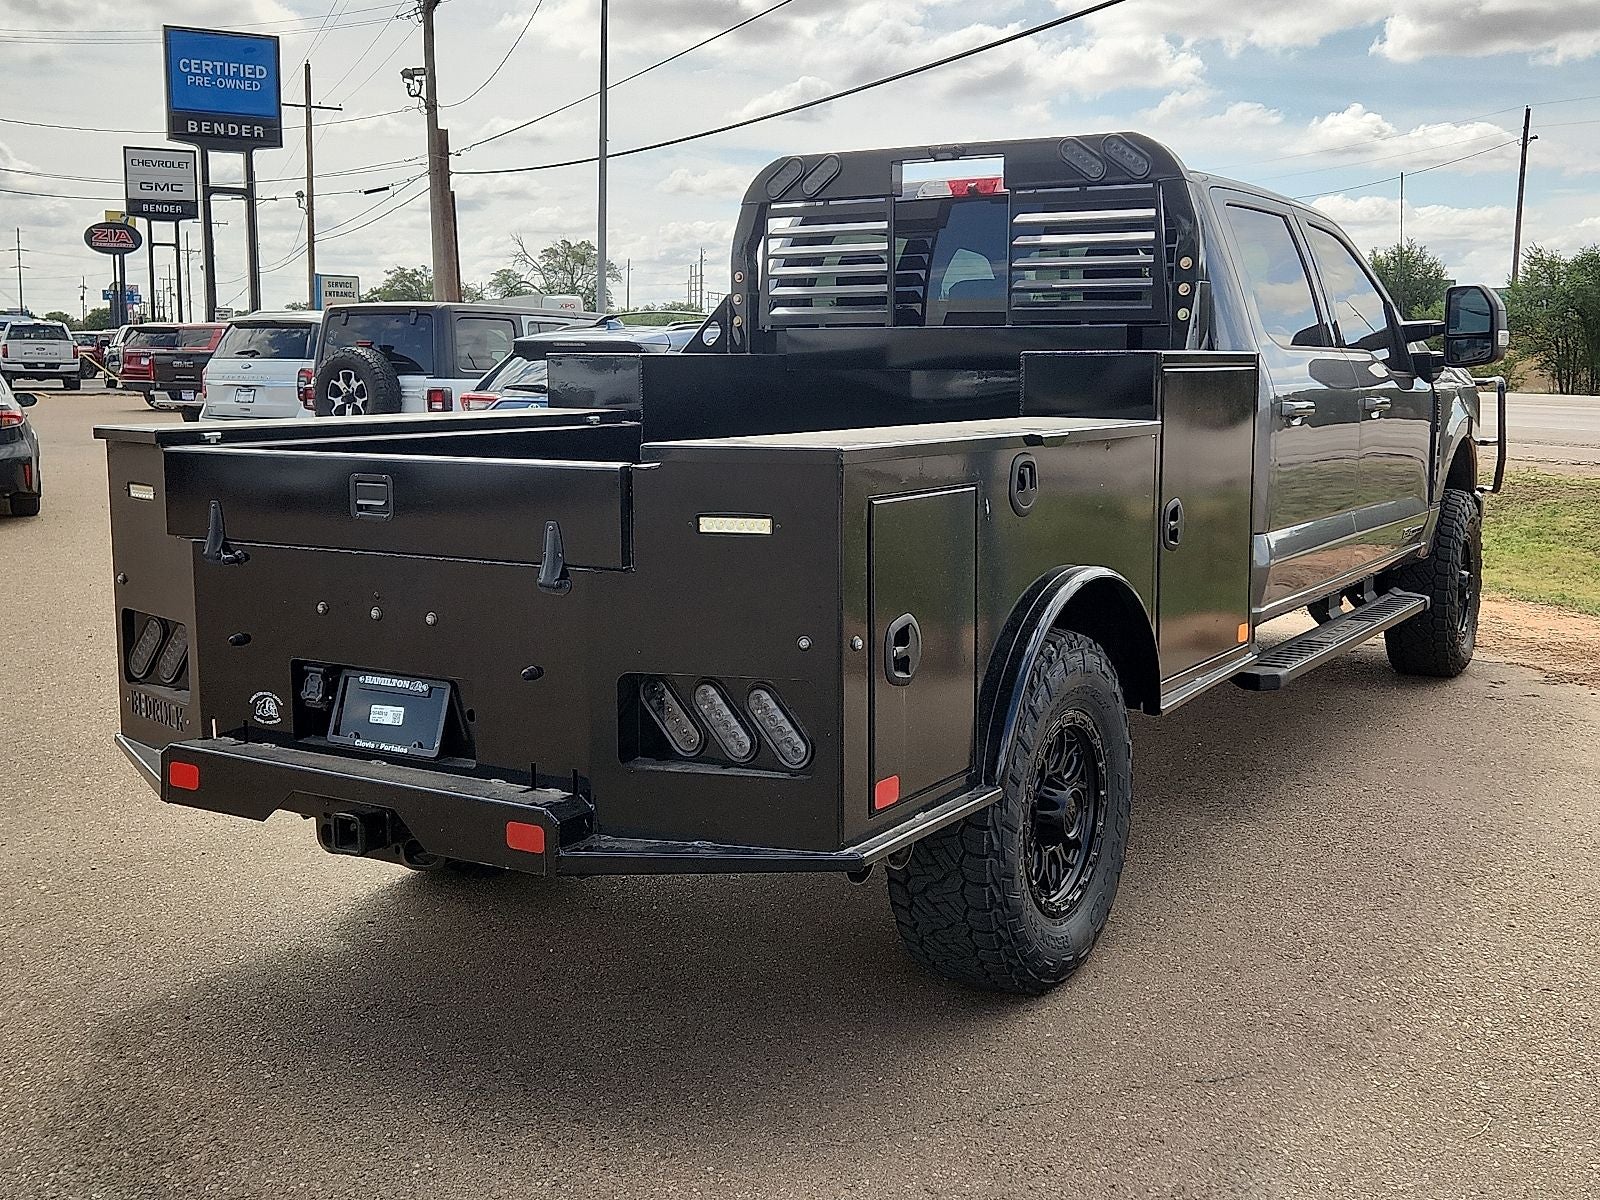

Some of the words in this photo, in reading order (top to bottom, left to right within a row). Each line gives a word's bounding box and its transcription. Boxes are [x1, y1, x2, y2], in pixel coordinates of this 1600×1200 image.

[179, 58, 268, 79] CERTIFIED
[187, 75, 261, 91] PRE-OWNED
[187, 120, 264, 138] BENDER
[130, 158, 190, 170] CHEVROLET
[139, 181, 184, 193] GMC
[142, 203, 182, 213] BENDER
[91, 228, 134, 244] ZIA
[327, 281, 353, 289] SERVICE
[324, 290, 356, 299] ENTRANCE
[172, 360, 194, 368] GMC
[364, 675, 411, 689] HAMILTON
[131, 690, 185, 733] BEDROCK
[354, 739, 375, 749] Clovis
[379, 743, 408, 754] Portales
